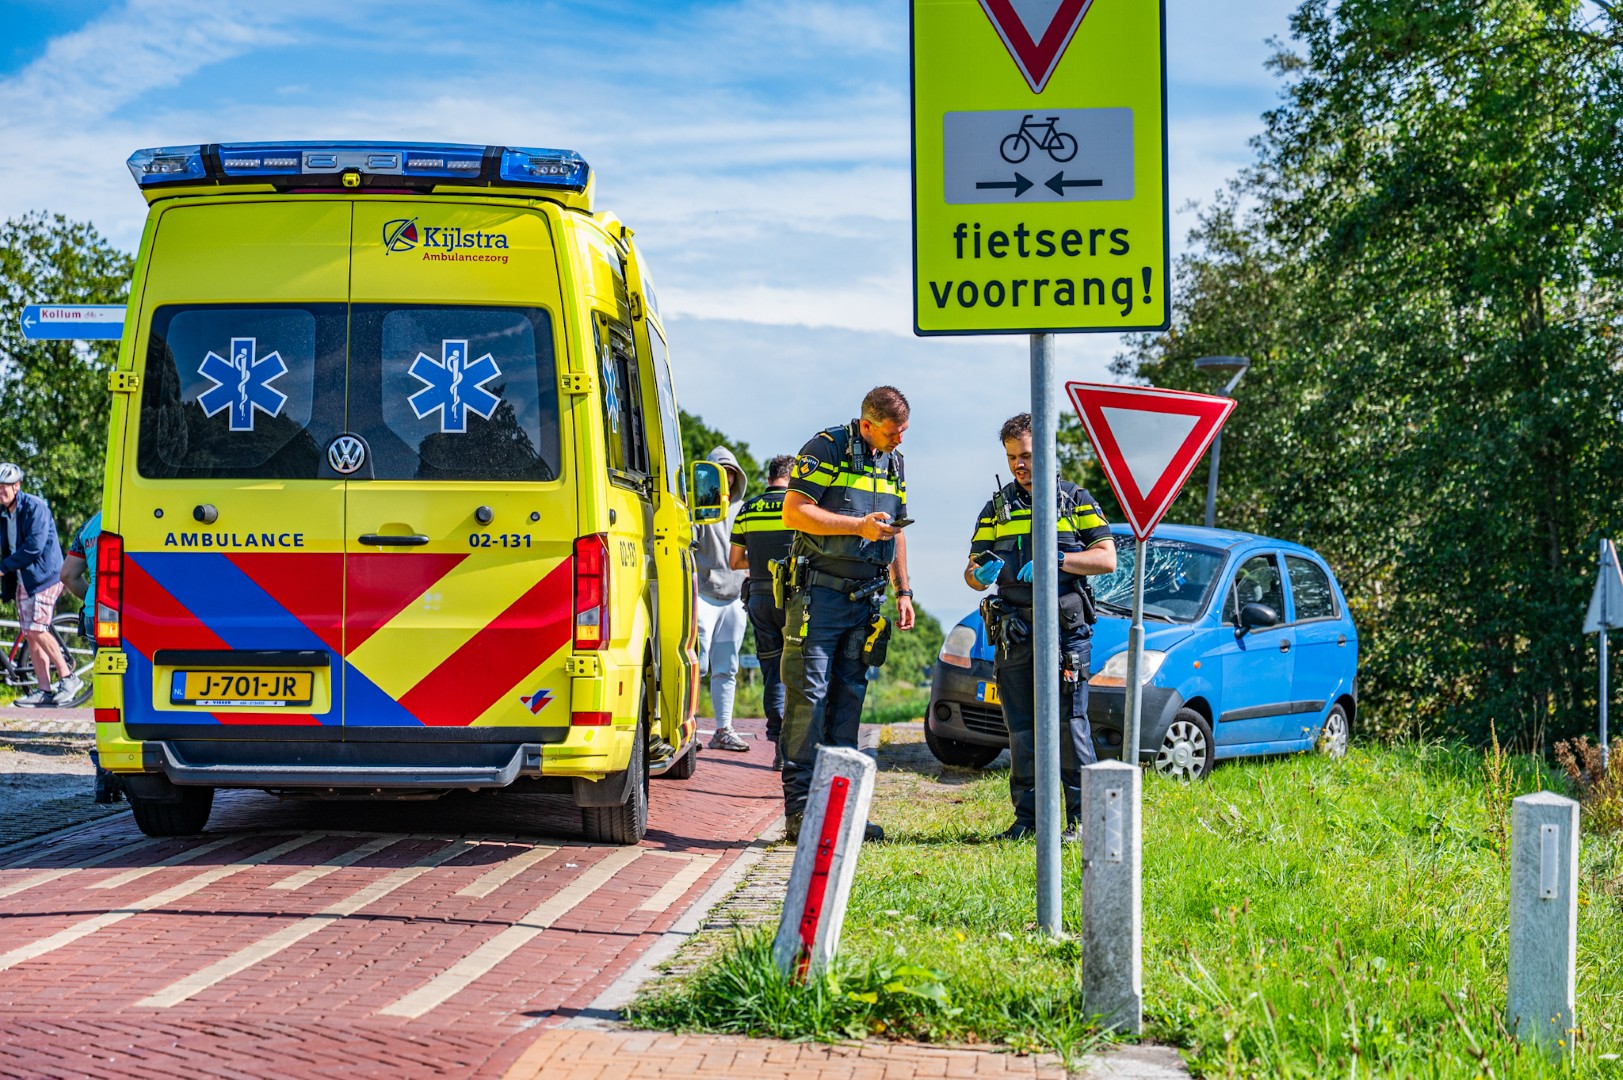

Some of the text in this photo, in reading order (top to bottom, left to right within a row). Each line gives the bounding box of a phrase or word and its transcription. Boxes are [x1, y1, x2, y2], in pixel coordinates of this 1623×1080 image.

[423, 227, 509, 252] Kijlstra
[953, 222, 1130, 259] fietsers
[422, 252, 509, 264] Ambulancezorg
[929, 266, 1152, 317] voorrang!
[42, 310, 81, 319] Kollum
[164, 532, 304, 547] AMBULANCE
[468, 533, 531, 548] 02-131
[173, 676, 297, 697] NL J-701-JR
